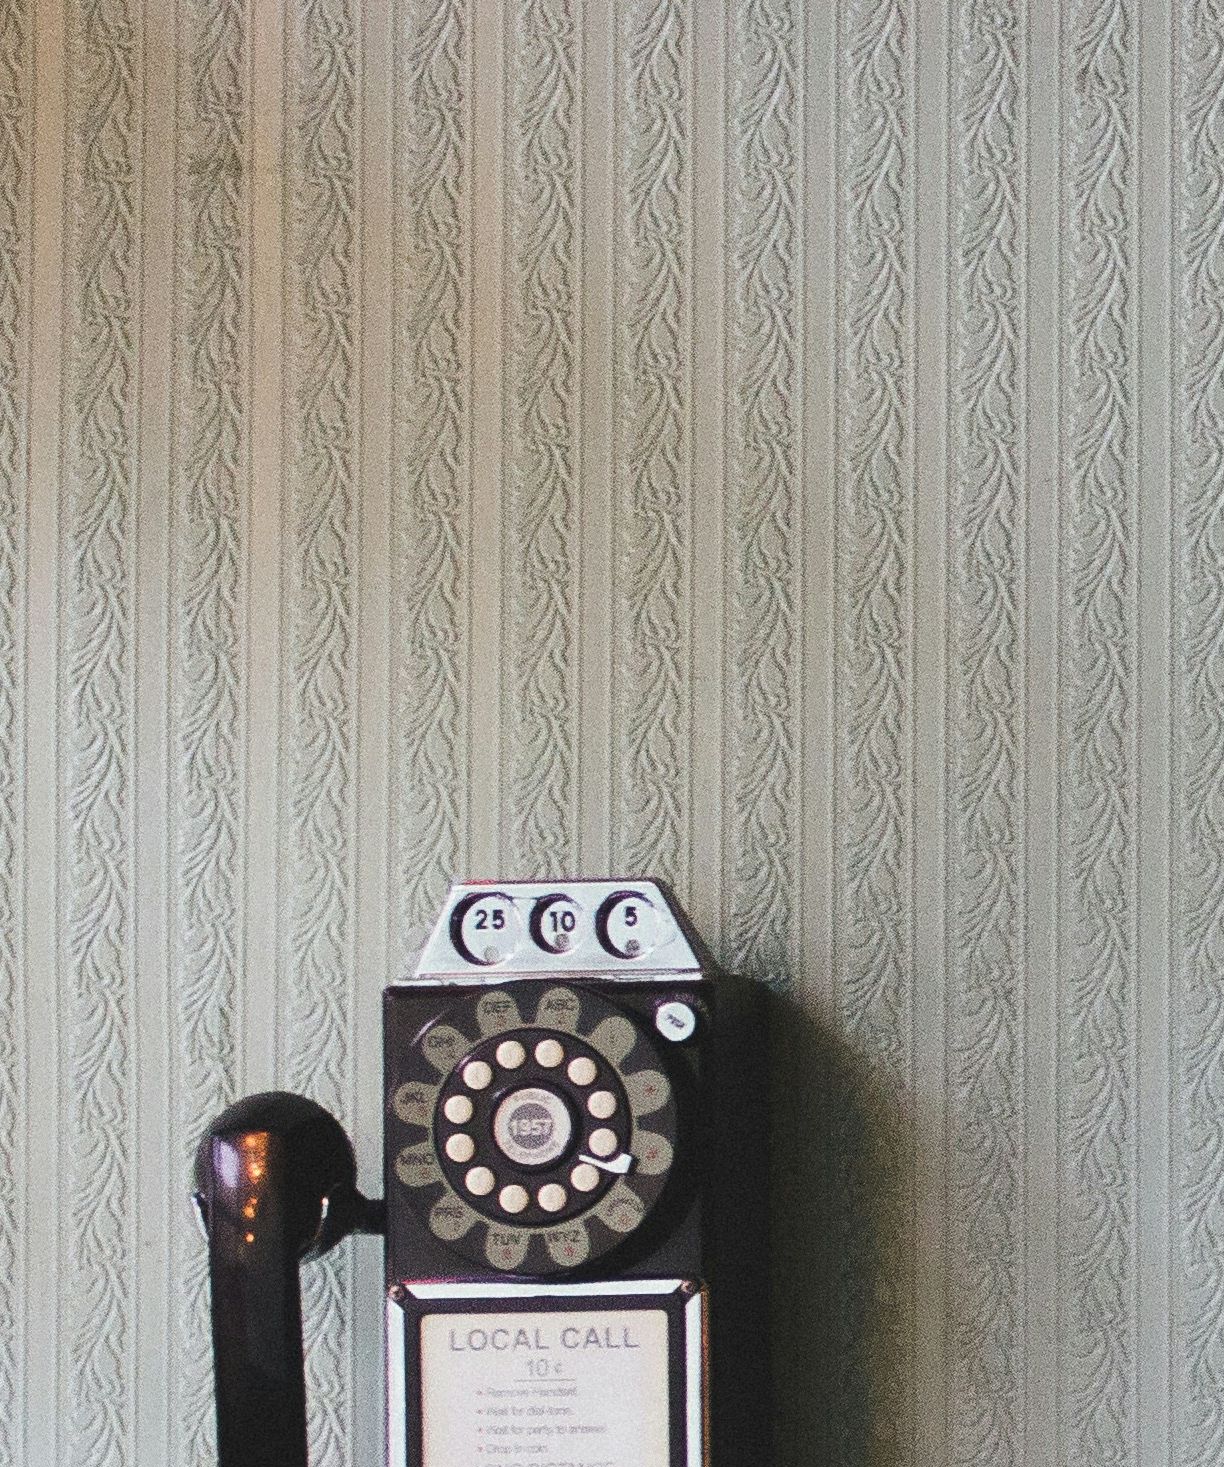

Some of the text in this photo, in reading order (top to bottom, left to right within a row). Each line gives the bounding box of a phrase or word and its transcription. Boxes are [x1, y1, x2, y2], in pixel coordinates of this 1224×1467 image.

[475, 910, 506, 930] 25
[549, 911, 576, 932] 10
[624, 907, 638, 927] 5
[509, 1119, 552, 1136] 1957
[449, 1327, 640, 1352] LOCAL CALL
